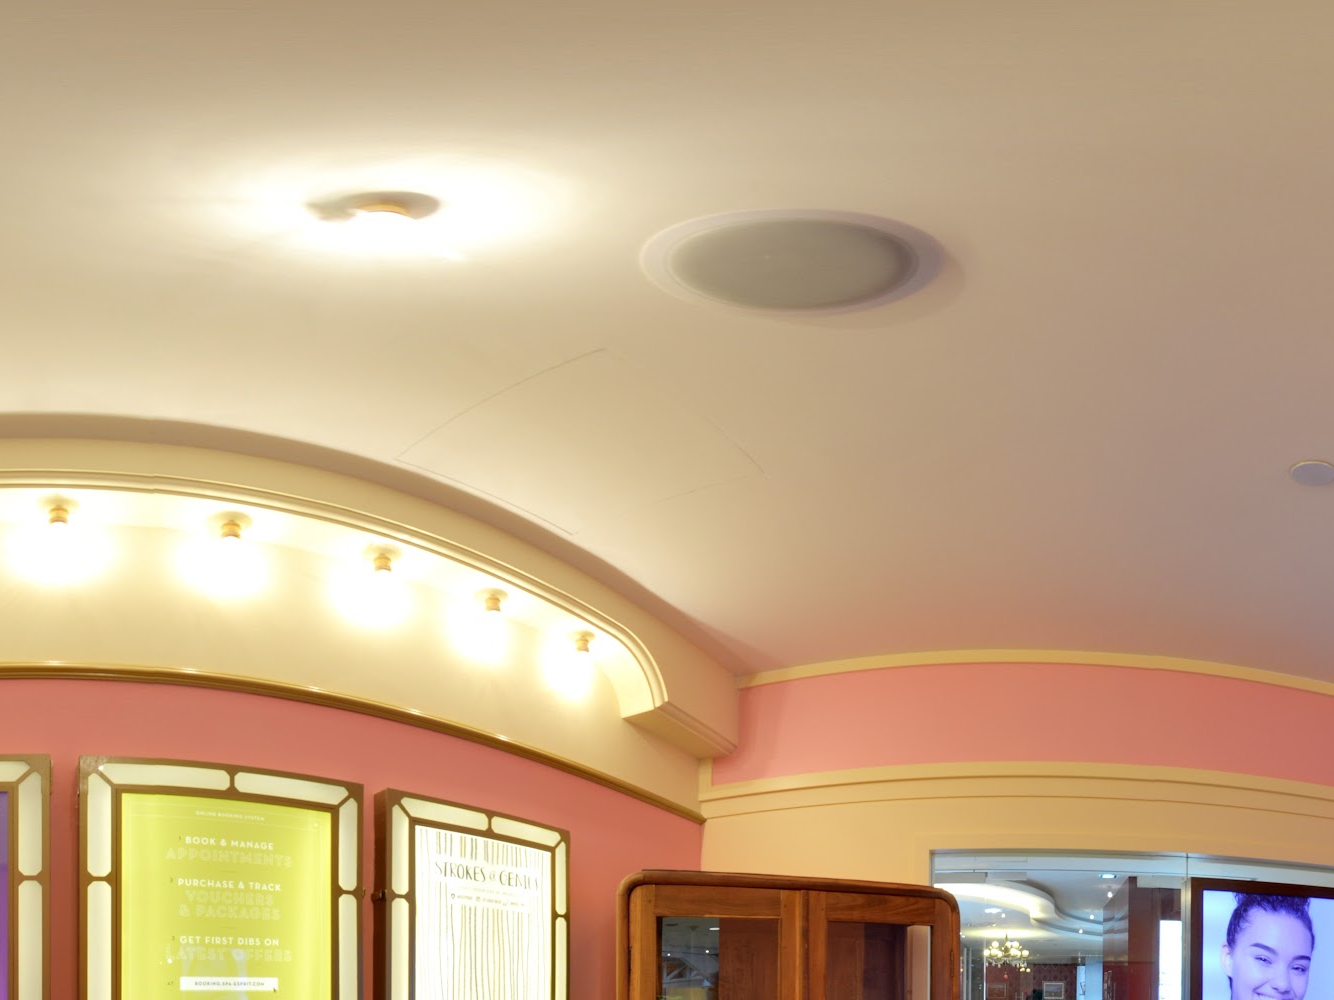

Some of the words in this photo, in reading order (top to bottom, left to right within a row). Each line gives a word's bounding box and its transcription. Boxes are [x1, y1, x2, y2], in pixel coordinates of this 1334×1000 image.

[185, 836, 216, 846] BOOK
[220, 838, 227, 846] &
[231, 839, 274, 851] MANAGE
[165, 848, 292, 868] APPOINTMENTS
[435, 861, 486, 883] STROKES
[178, 877, 234, 889] PURCHASE
[238, 881, 245, 889] &
[249, 882, 281, 891] TRACK
[185, 889, 275, 906] VOUCHERS
[195, 905, 280, 920] PACKAGES
[179, 935, 201, 944] GET
[205, 936, 234, 945] FIRST
[238, 937, 260, 946] DIBS
[264, 937, 279, 946] ON
